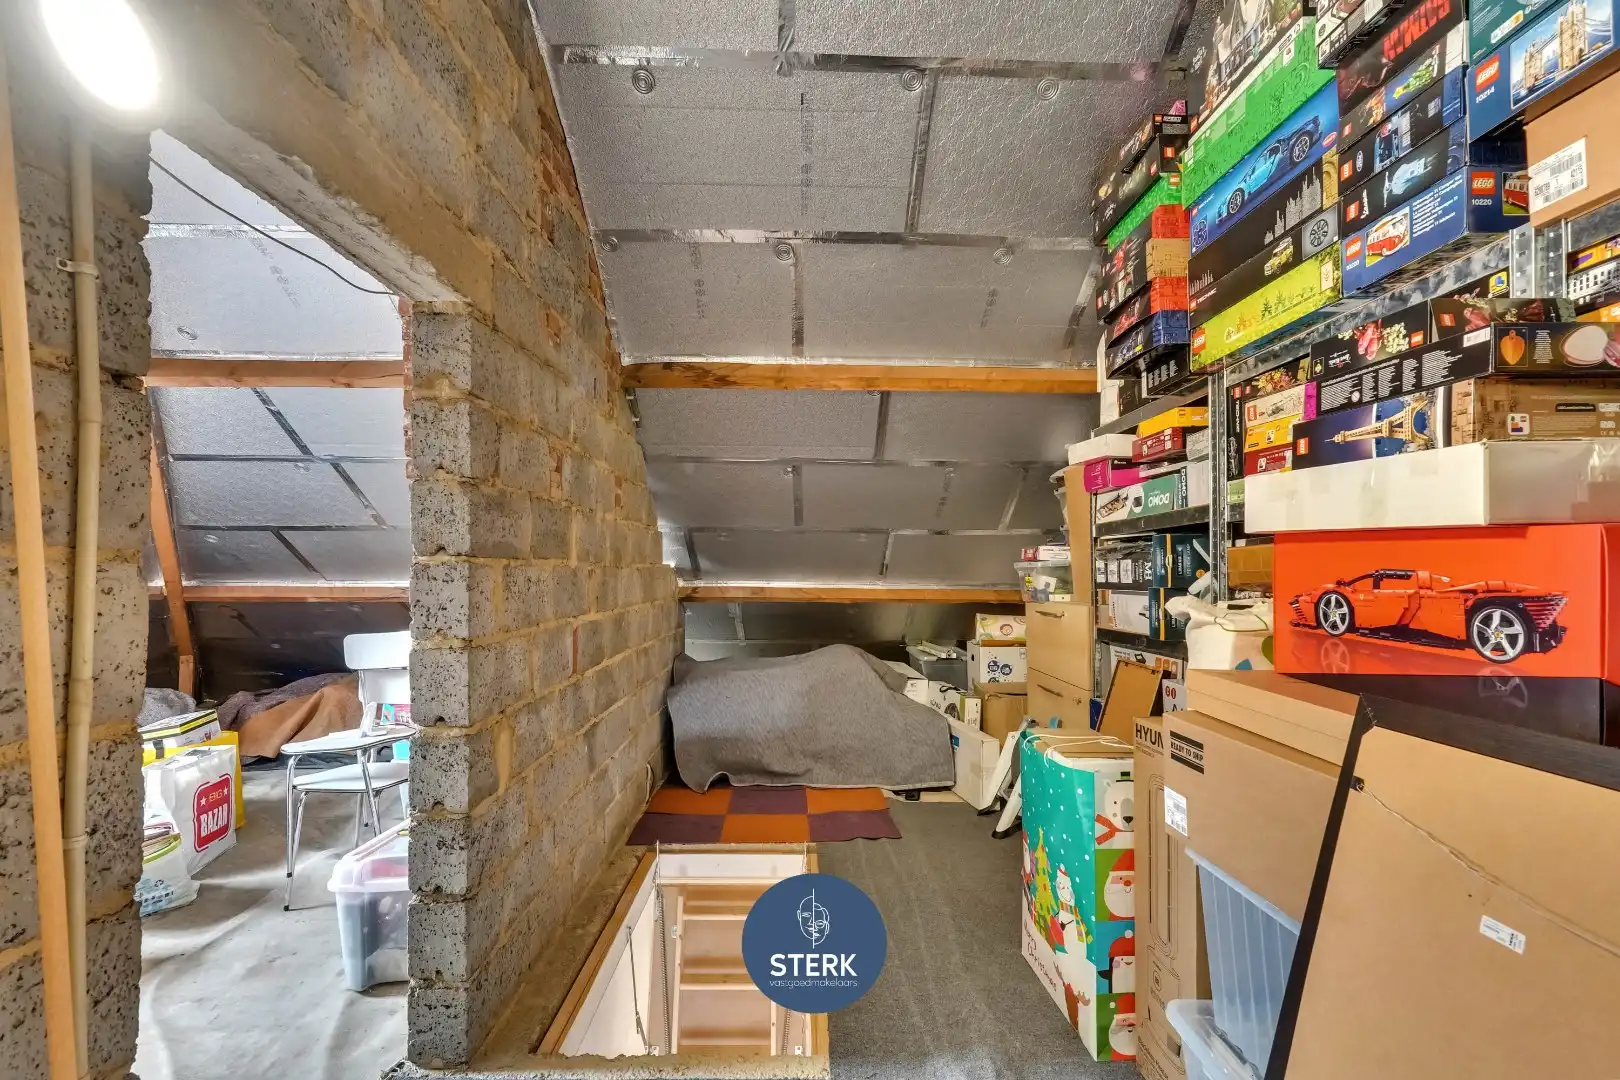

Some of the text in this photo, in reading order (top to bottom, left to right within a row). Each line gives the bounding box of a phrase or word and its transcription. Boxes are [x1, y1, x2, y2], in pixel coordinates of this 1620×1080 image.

[1476, 60, 1499, 86] LEGO
[1475, 85, 1495, 103] 10214
[1472, 177, 1493, 189] LEGO
[1471, 198, 1492, 206] 10220
[1148, 493, 1170, 508] DOMO
[1171, 740, 1185, 754] READY
[1185, 747, 1192, 757] TO
[1193, 751, 1204, 762] SHIP
[209, 789, 222, 802] BIG
[200, 803, 228, 838] BAZAR
